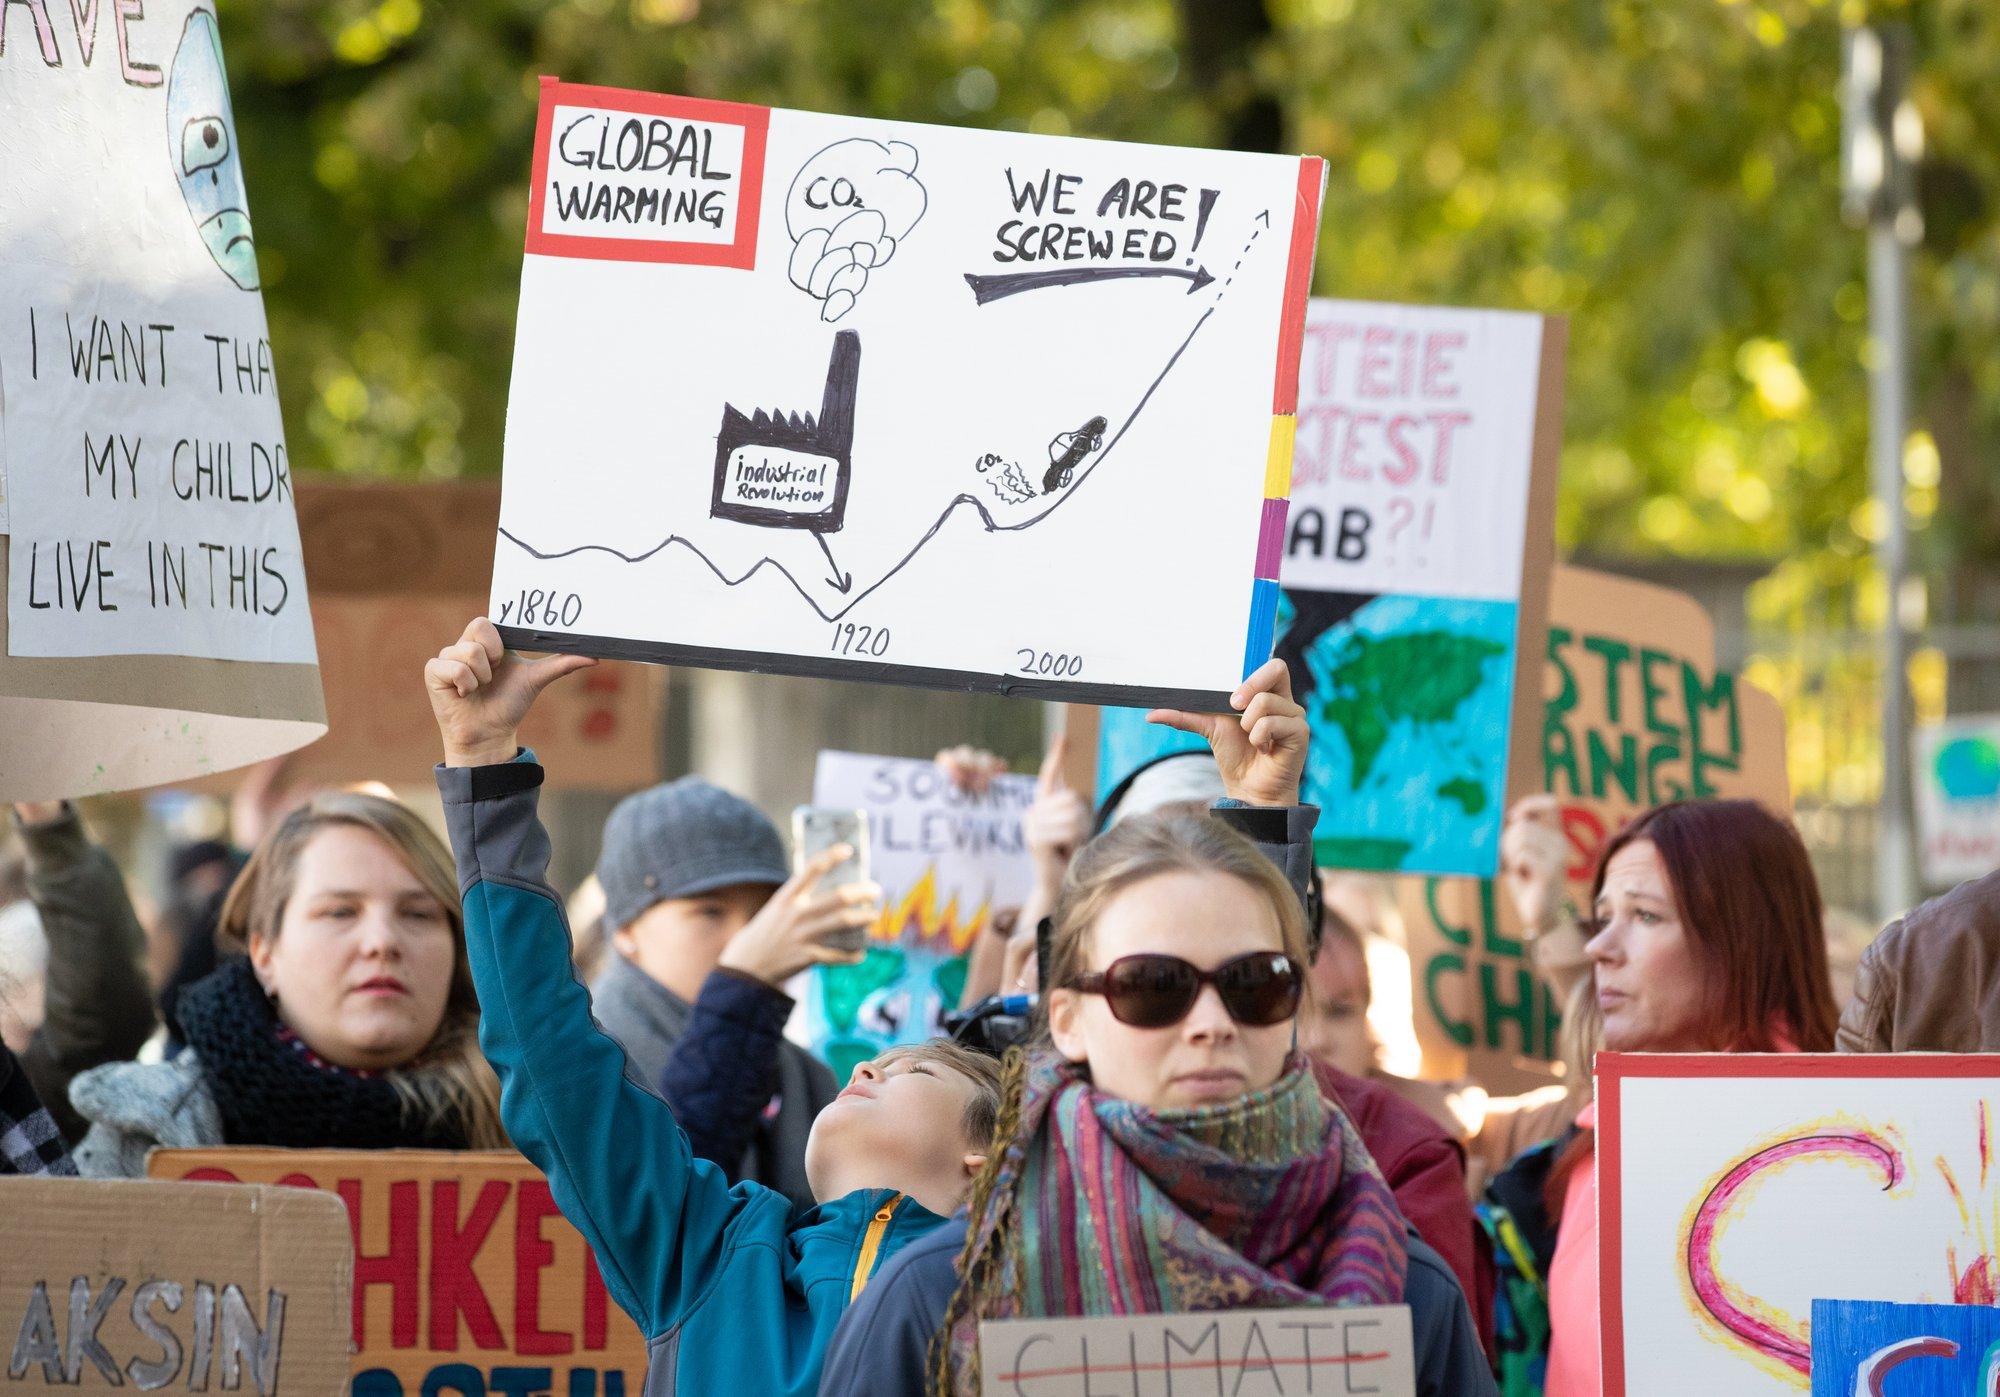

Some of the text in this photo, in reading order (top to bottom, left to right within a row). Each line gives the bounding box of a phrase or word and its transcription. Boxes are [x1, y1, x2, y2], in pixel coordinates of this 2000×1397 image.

[558, 114, 731, 179] GLOBAL
[552, 181, 725, 229] WARMING
[1005, 167, 1188, 221] WE ARE
[30, 307, 37, 380] I
[66, 312, 174, 388] WANT
[85, 432, 141, 499] MY
[737, 483, 825, 502] Revolution
[29, 541, 288, 616] LIVE IN THIS
[831, 622, 889, 656] 1920
[1017, 648, 1083, 676] 2000
[7, 1275, 288, 1397] AKSIN
[1013, 1318, 1384, 1397] CLIMATE
